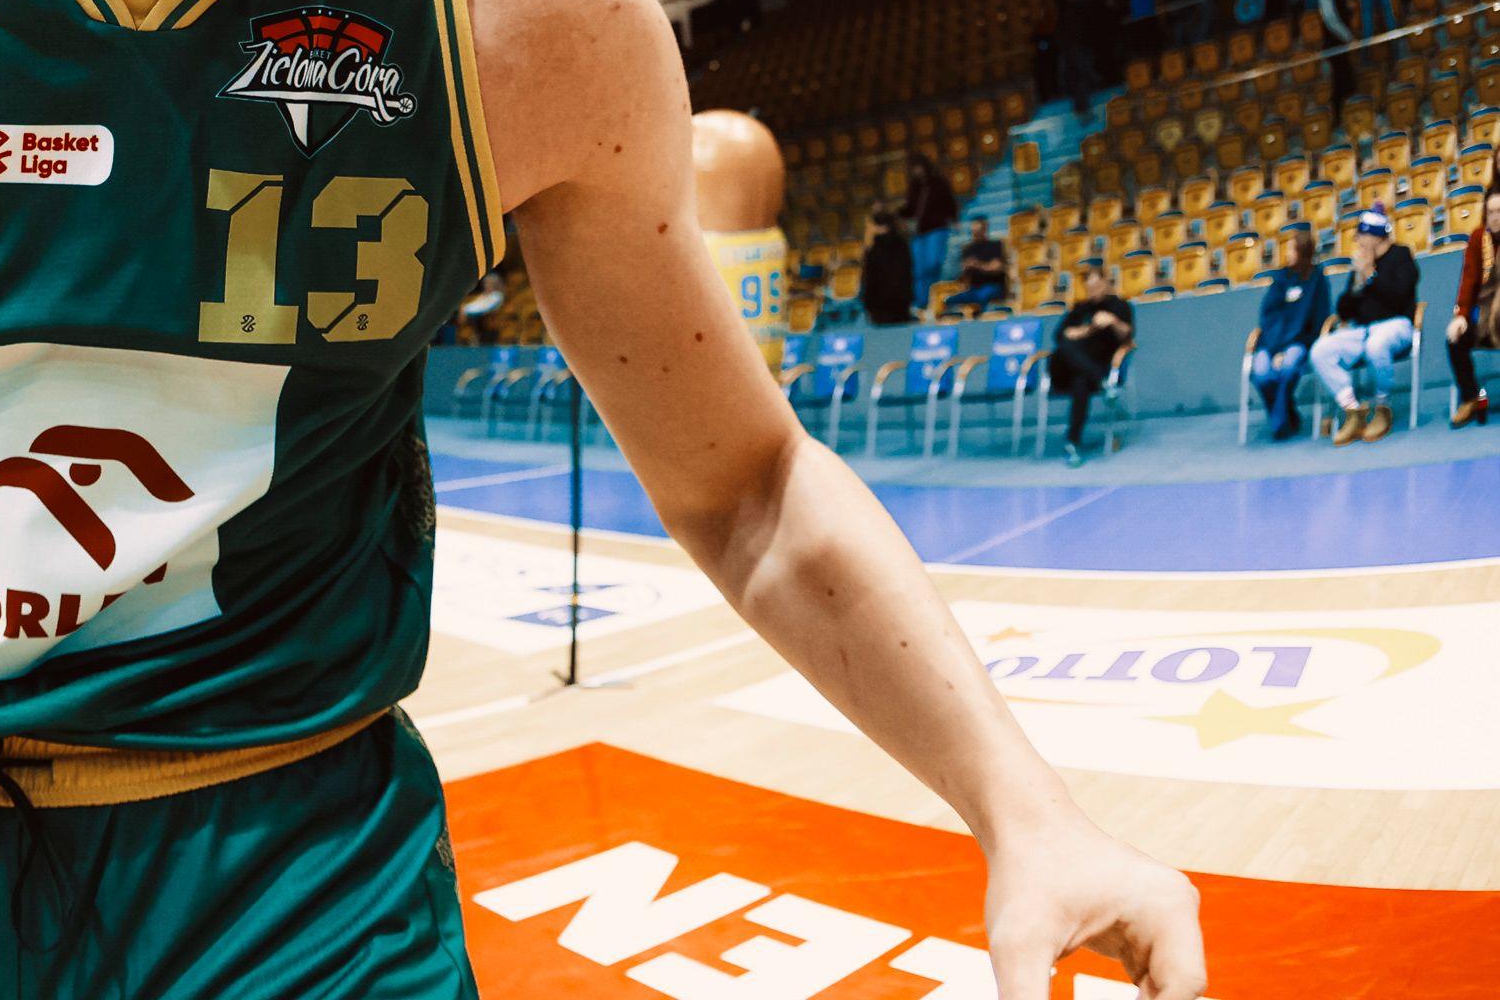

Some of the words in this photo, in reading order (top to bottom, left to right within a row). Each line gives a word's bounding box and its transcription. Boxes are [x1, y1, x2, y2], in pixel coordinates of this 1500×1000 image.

[227, 40, 327, 91] Zielona
[21, 132, 99, 152] Basket
[20, 154, 68, 179] Liga
[198, 168, 430, 345] 13
[982, 645, 1313, 689] LOTTO
